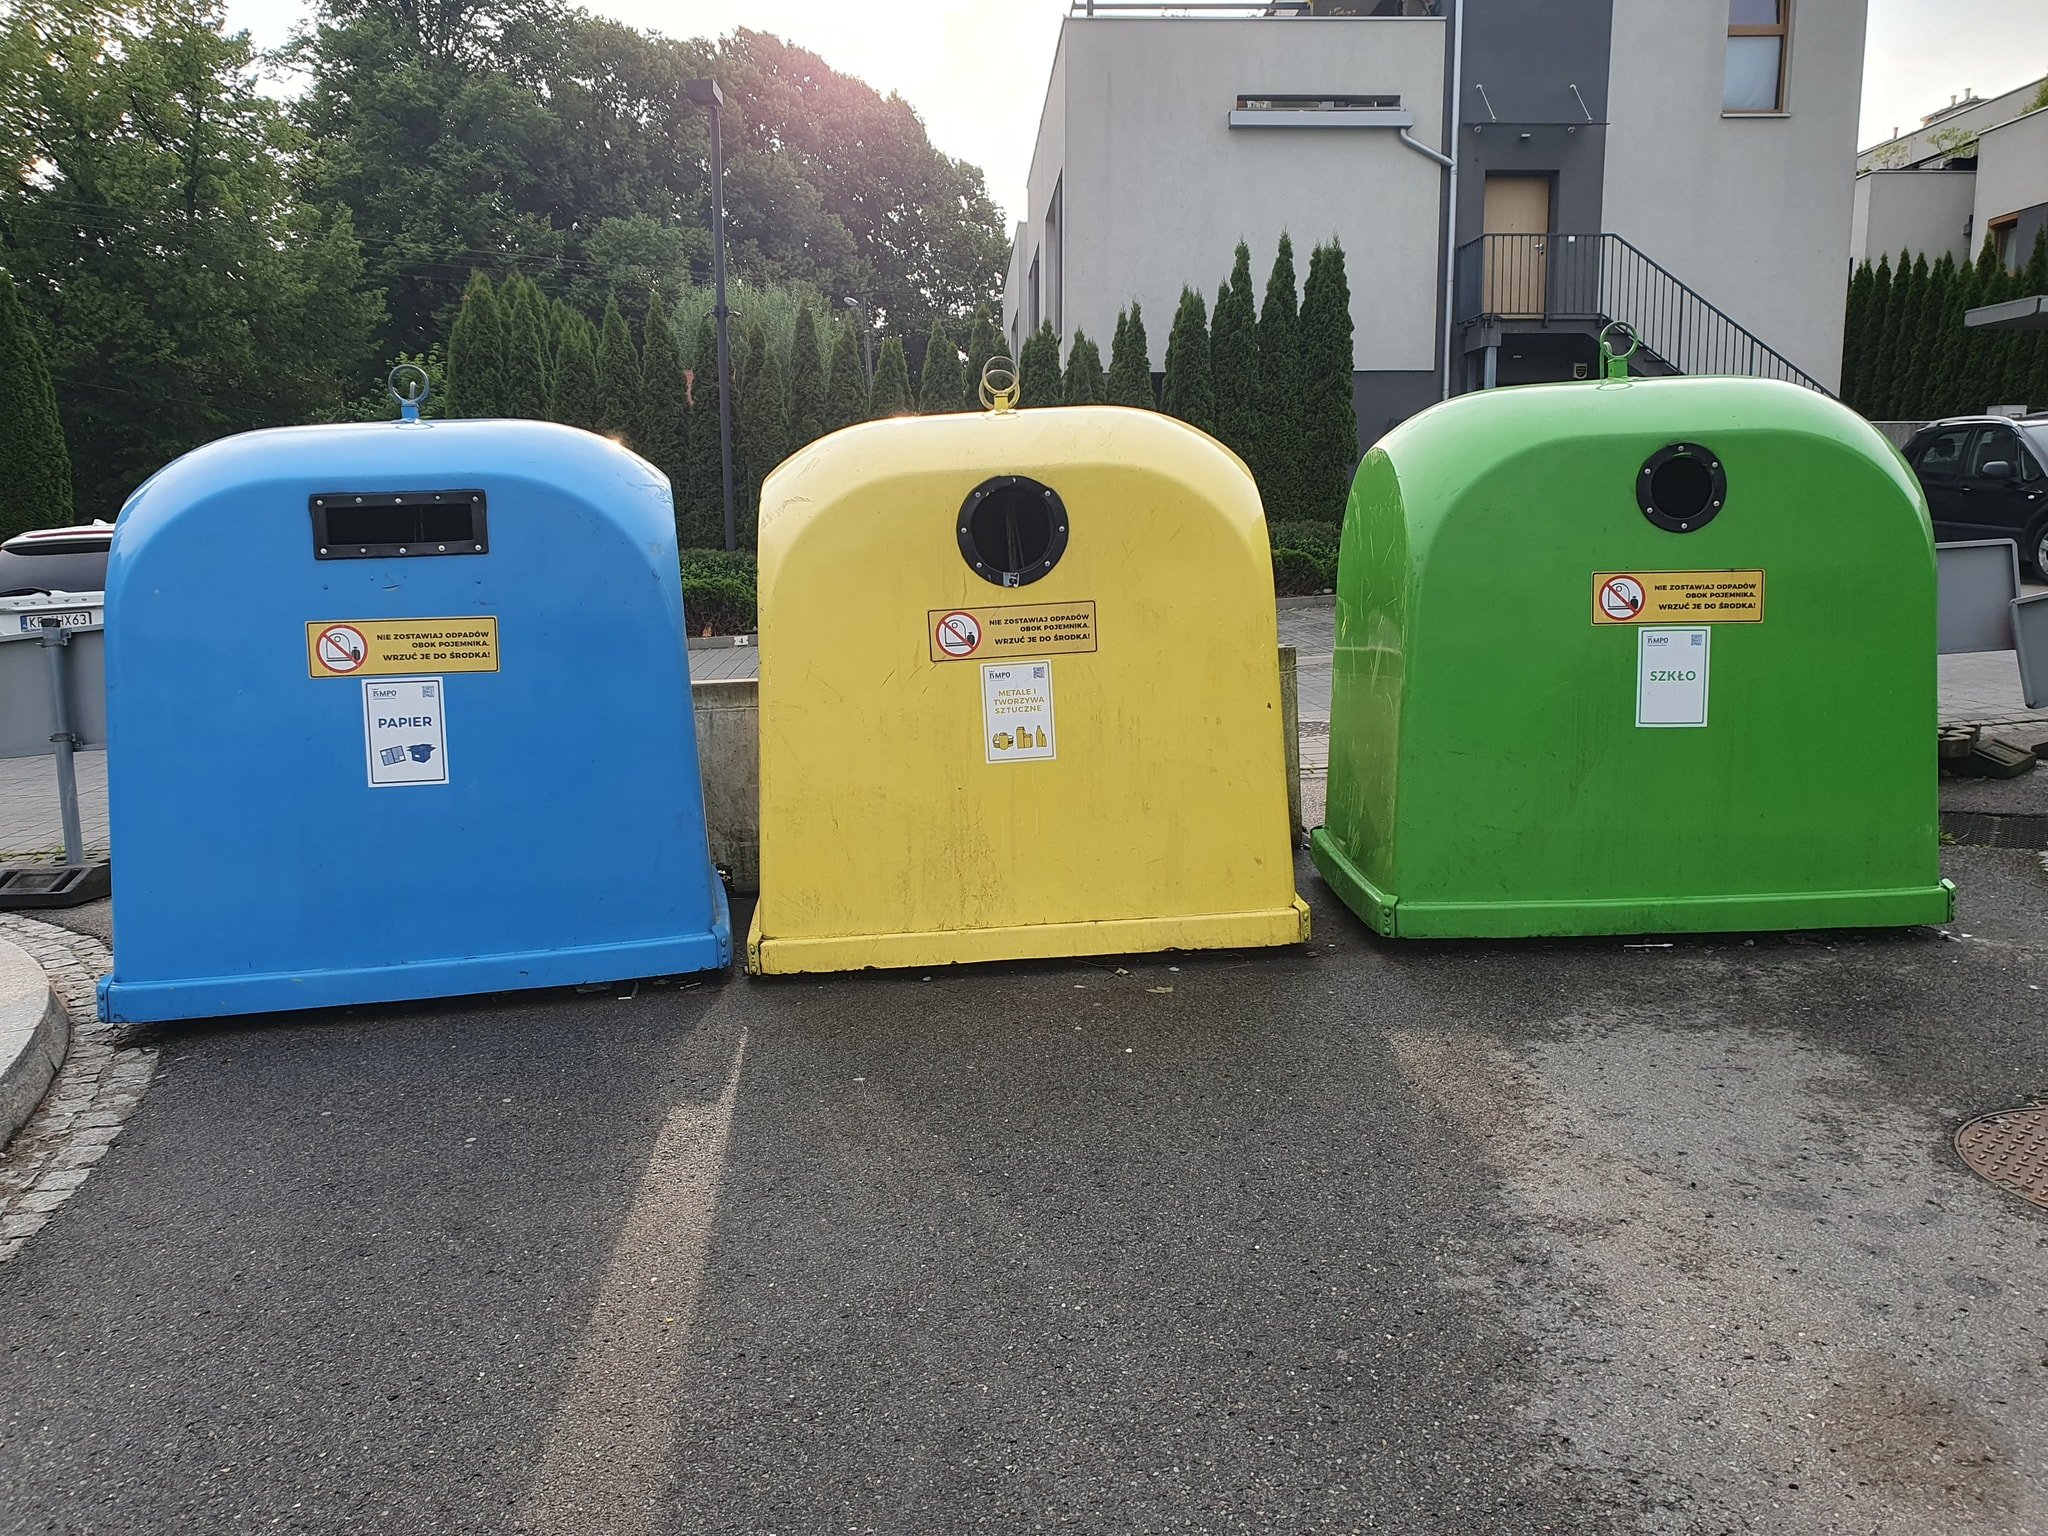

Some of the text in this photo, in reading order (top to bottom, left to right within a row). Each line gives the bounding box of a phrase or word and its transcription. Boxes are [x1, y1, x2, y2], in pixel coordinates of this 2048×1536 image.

[1716, 582, 1757, 590] ODPADÓW
[1658, 602, 1690, 610] WRZUĆ
[1718, 601, 1756, 609] ŚRODKA!
[50, 613, 87, 626] HX63
[1003, 616, 1048, 625] ZOSTAWIAJ
[1049, 614, 1090, 622] ODPADÓW
[1043, 622, 1090, 631] POJEMNIKA.
[393, 632, 443, 640] ZOSTAWIAJ
[445, 630, 490, 639] ODPADÓW
[994, 636, 1025, 645] WRZUĆ
[1053, 633, 1090, 641] ŚRODKA!
[438, 640, 490, 648] POJEMNIKA.
[382, 652, 418, 661] WRZUĆ
[449, 651, 491, 659] ŚRODKA!
[1650, 670, 1696, 682] SZKŁO
[998, 688, 1032, 697] METALE
[993, 696, 1045, 706] TWORZYWA
[994, 704, 1043, 715] SZTUCZNE
[378, 716, 433, 729] PAPIER
